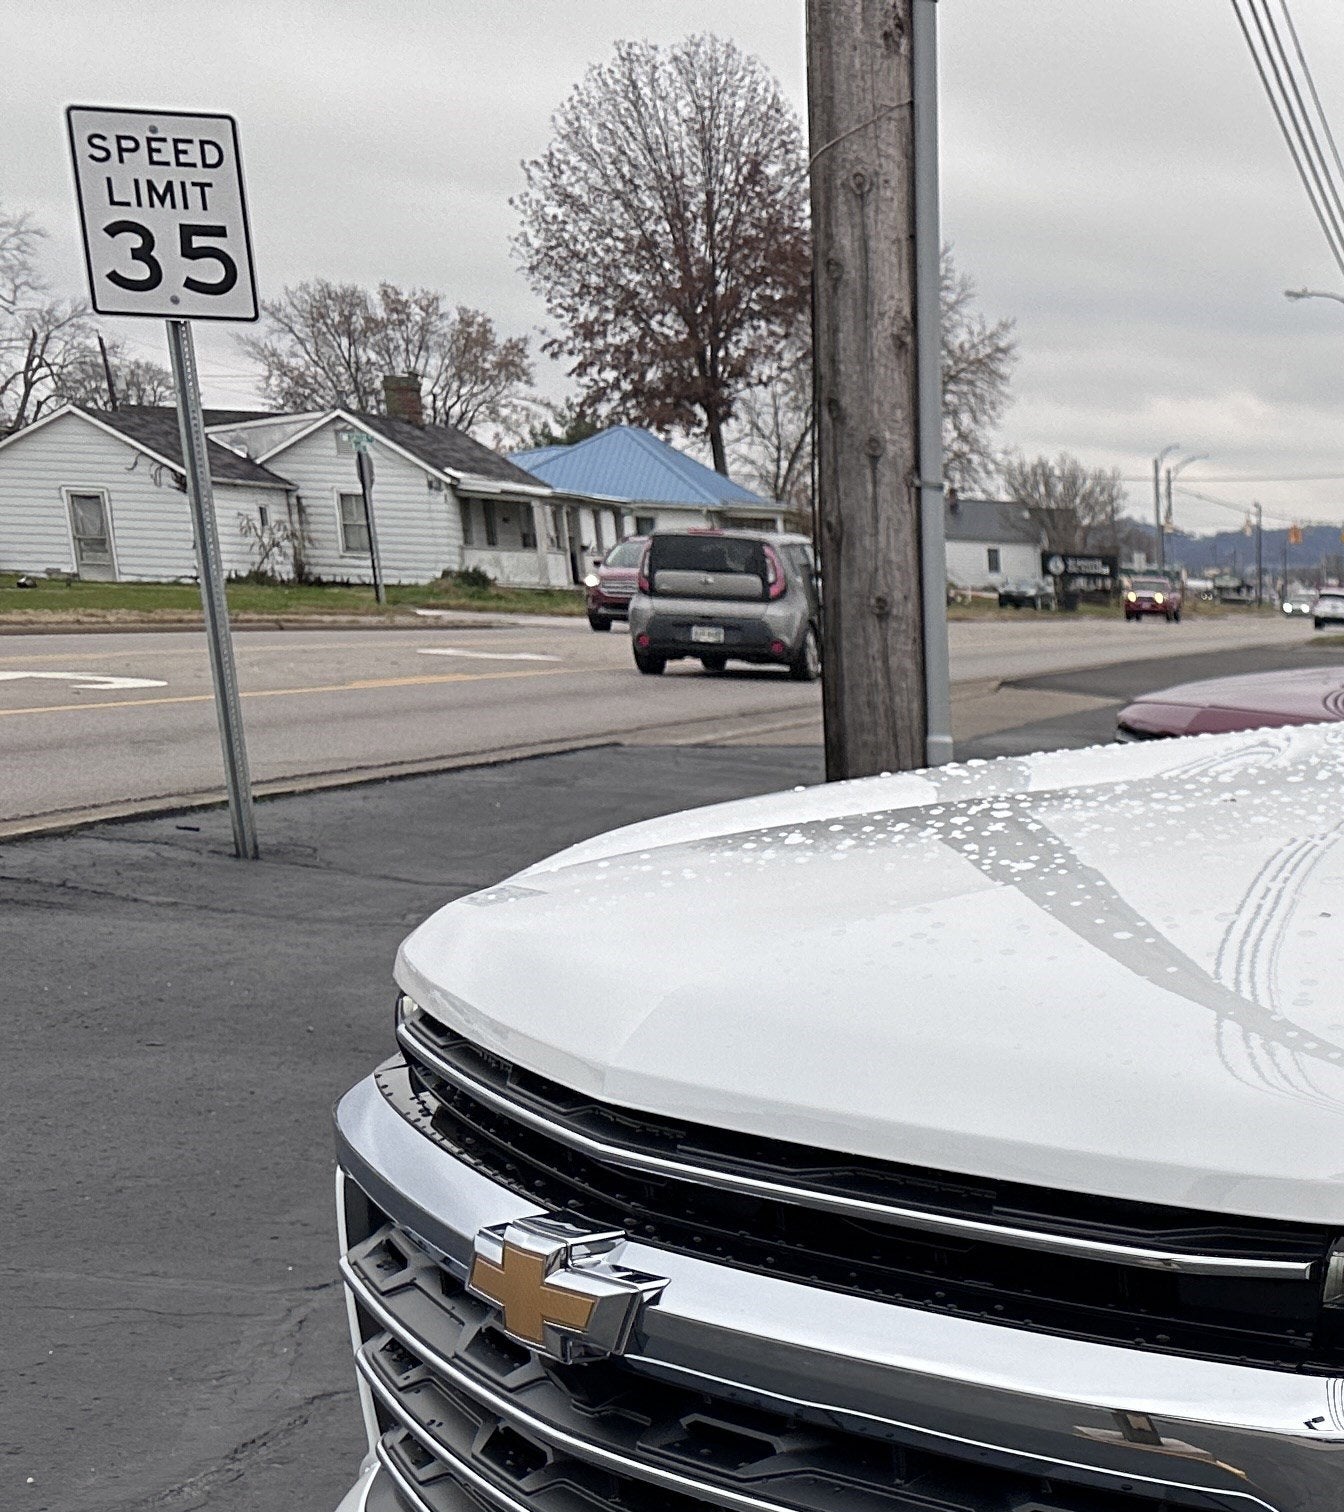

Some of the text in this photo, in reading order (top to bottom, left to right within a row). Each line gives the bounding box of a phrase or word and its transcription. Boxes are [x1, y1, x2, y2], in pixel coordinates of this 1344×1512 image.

[87, 133, 224, 169] SPEED
[106, 176, 213, 211] LIMIT
[103, 220, 238, 295] 35
